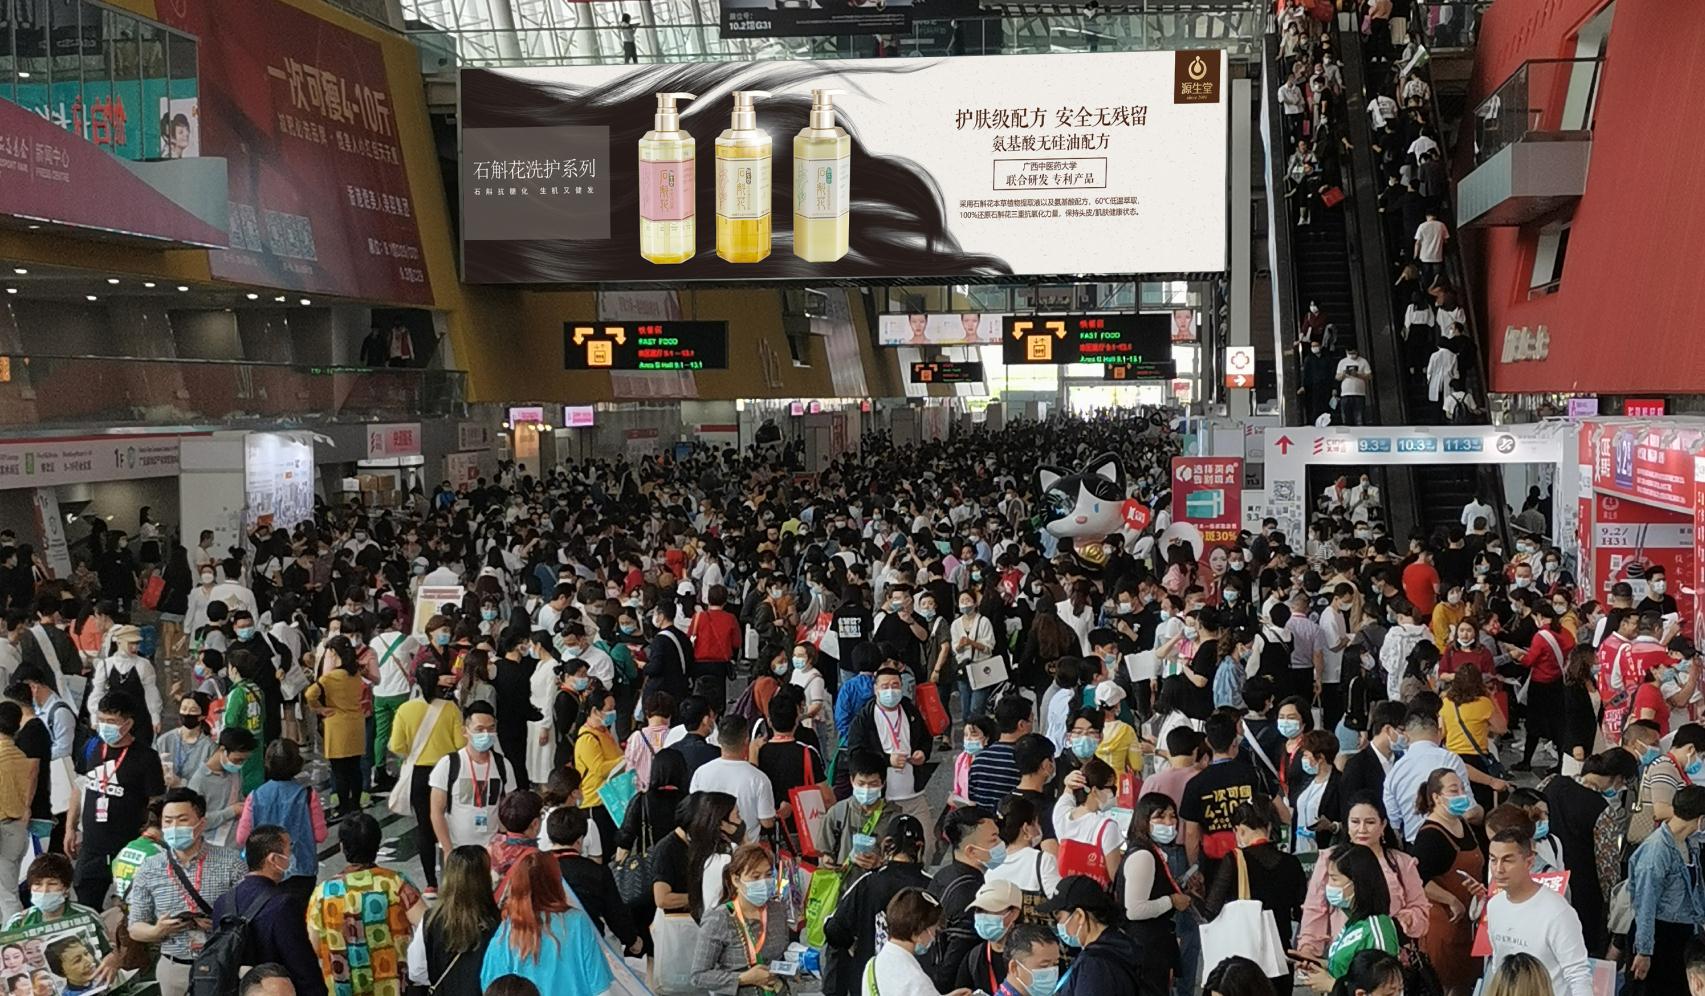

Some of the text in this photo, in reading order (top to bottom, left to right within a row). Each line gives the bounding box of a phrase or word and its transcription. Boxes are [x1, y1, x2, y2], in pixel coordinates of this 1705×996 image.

[1181, 82, 1213, 95] 源生堂
[955, 105, 1147, 131] 护肤级配方 安全无残留
[991, 132, 1110, 153] 氨基酸无硅油配方
[473, 158, 596, 180] 石斛花洗护系列
[1022, 161, 1078, 171] 广西中医药大学
[1006, 172, 1094, 186] 联合研发 专利产品
[1079, 332, 1121, 340] FAST FOOD
[1359, 440, 1378, 451] 9.3
[1399, 440, 1425, 451] 10.3
[1445, 440, 1471, 451] 11.3
[1601, 528, 1629, 536] 9.2/
